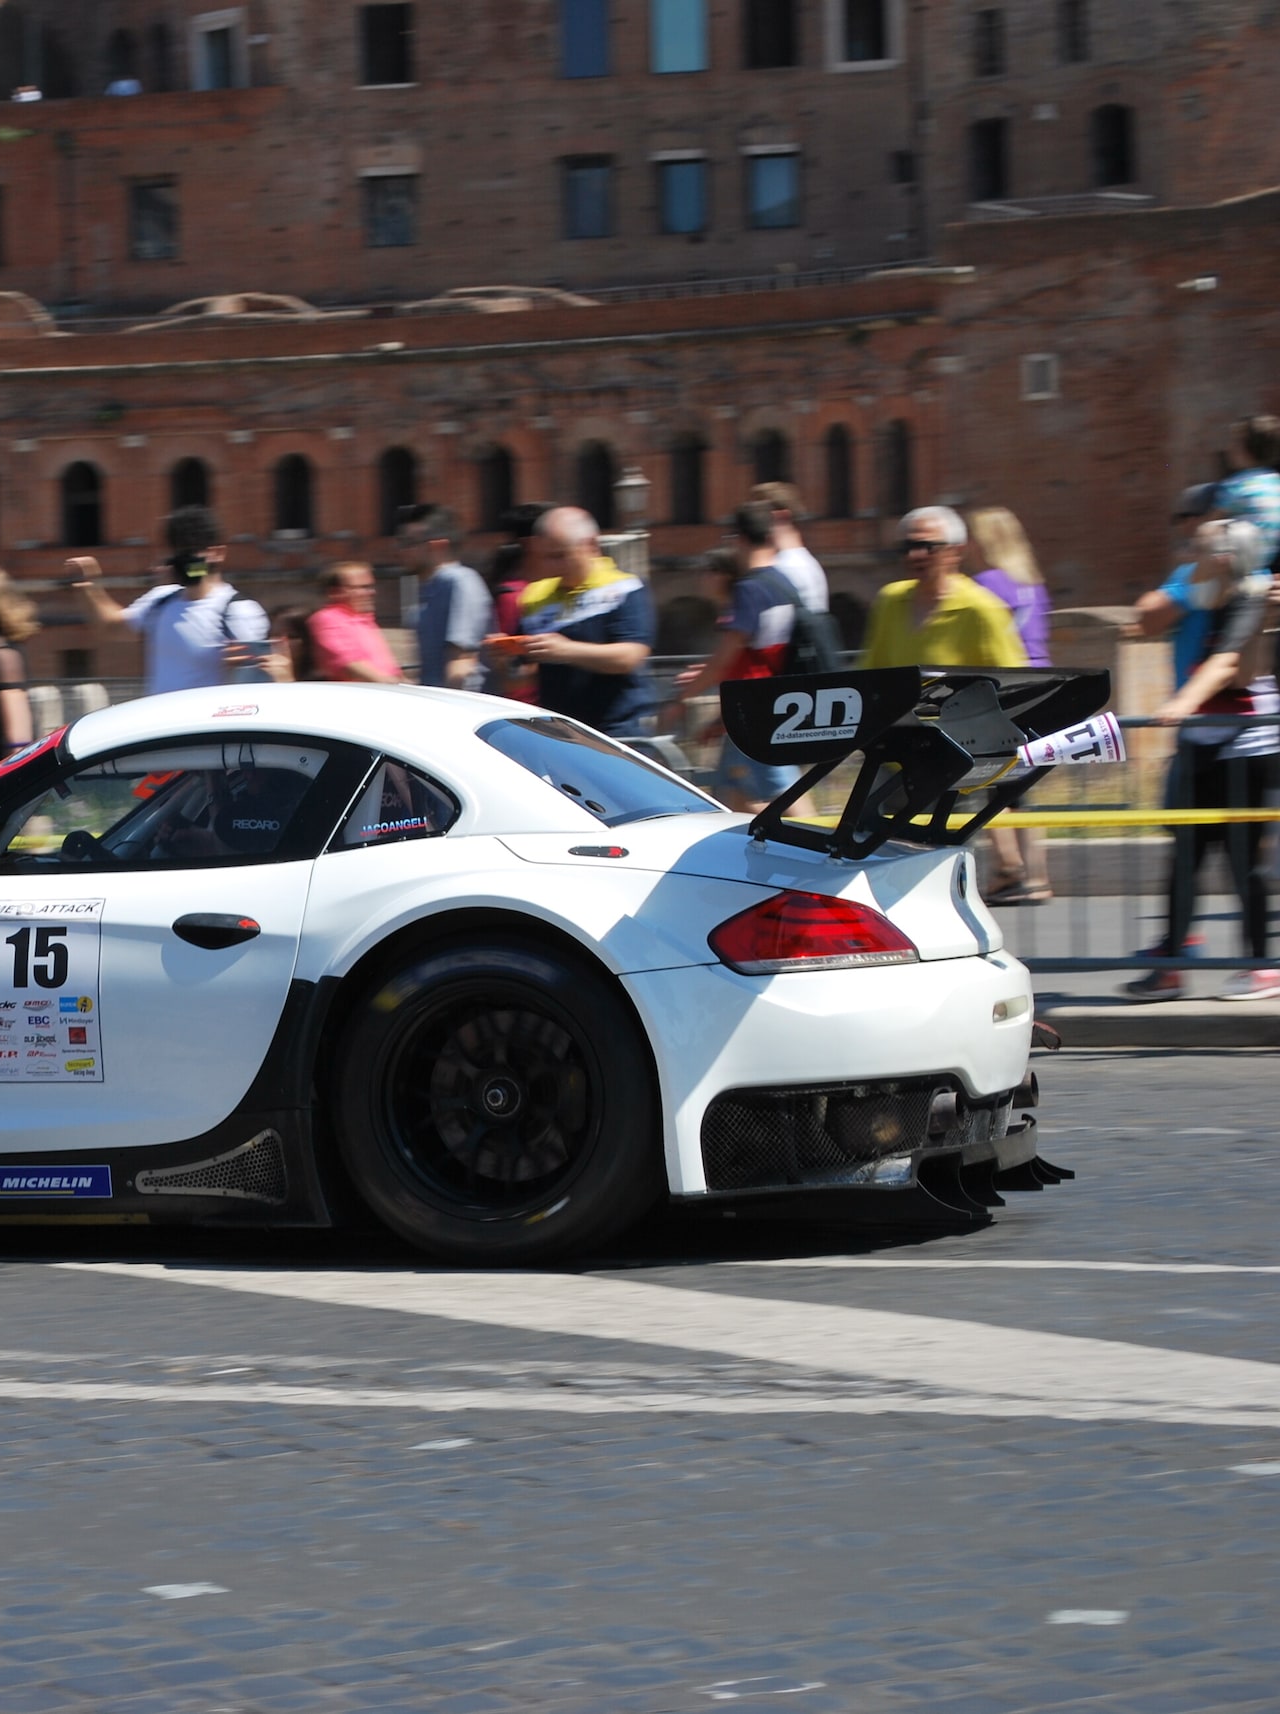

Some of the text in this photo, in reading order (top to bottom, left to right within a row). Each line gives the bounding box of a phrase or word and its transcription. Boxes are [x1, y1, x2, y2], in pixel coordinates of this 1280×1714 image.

[770, 687, 863, 744] 2D
[776, 729, 854, 740] 2d-datarecording.com
[232, 819, 280, 830] RECARO
[40, 902, 99, 913] ATTACK
[5, 926, 69, 988] 15
[28, 1016, 50, 1025] EBC
[2, 1177, 93, 1188] MICHELIN
